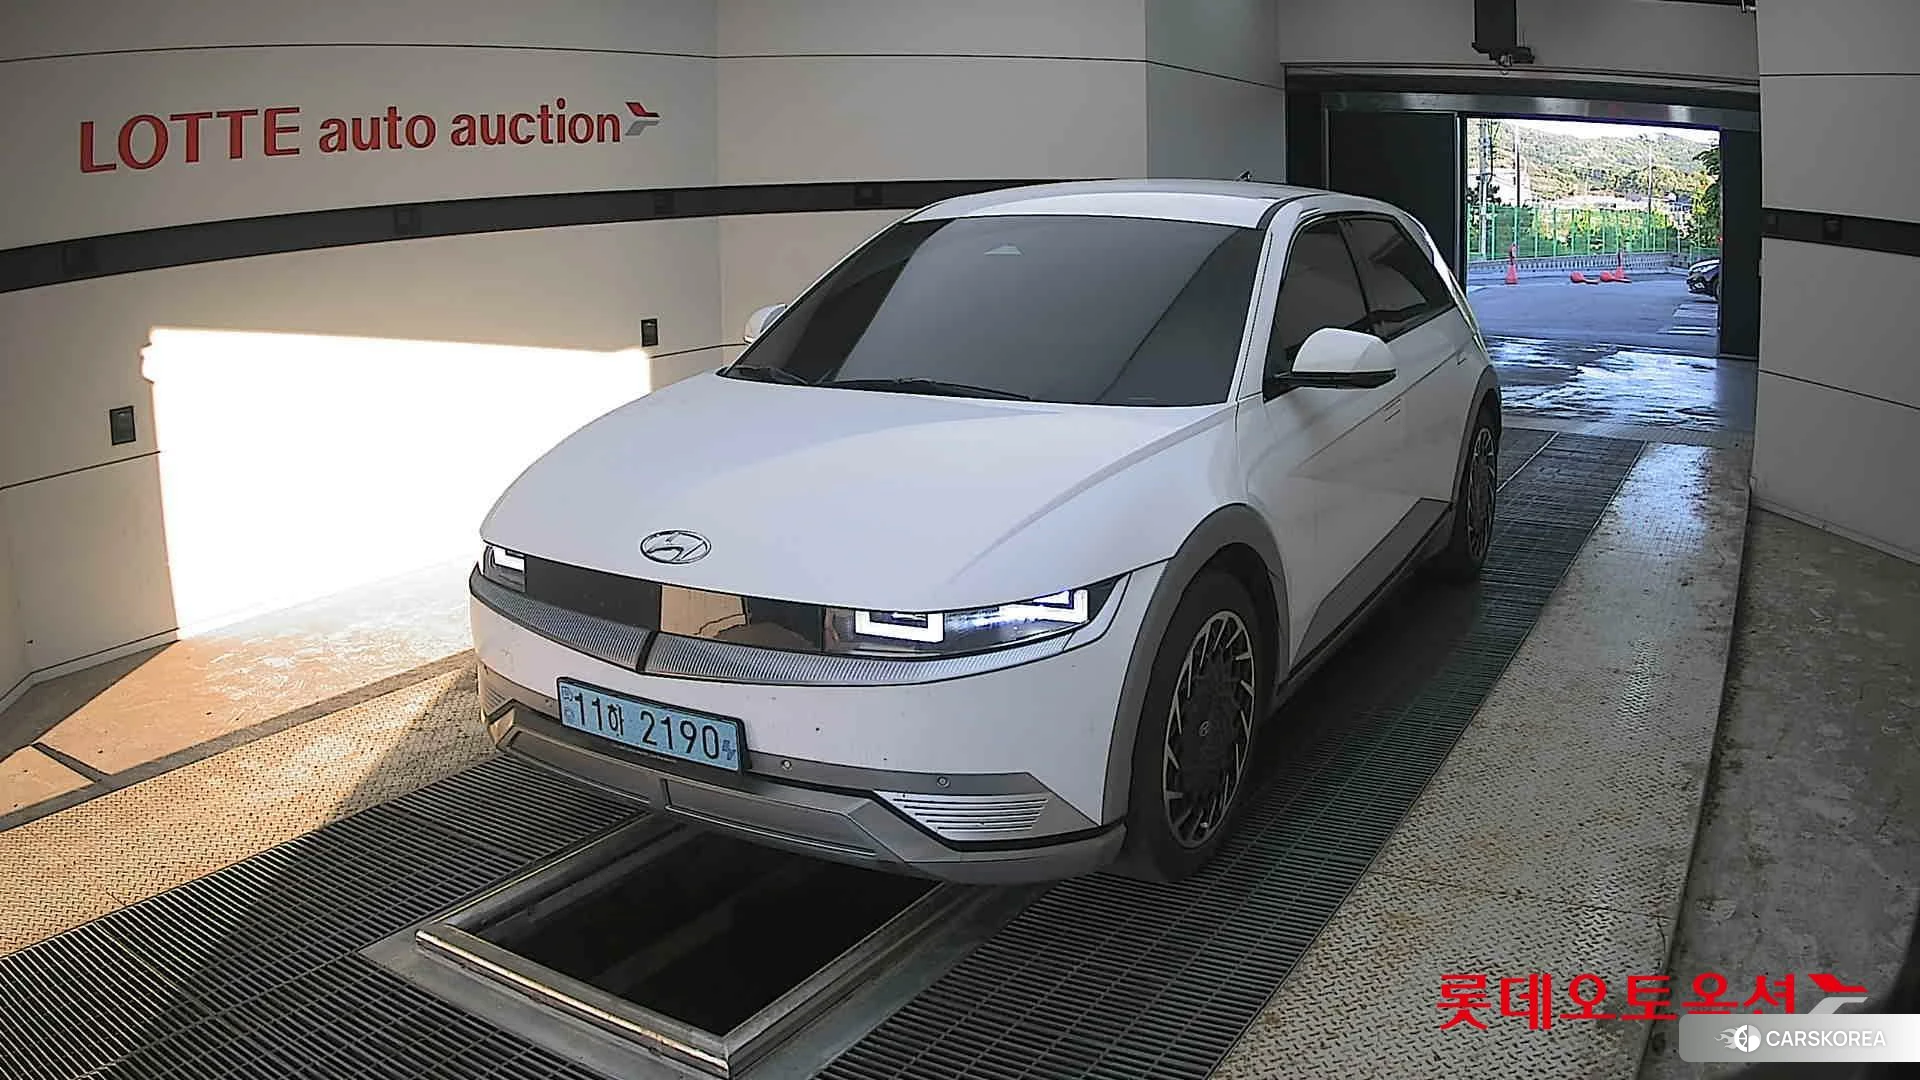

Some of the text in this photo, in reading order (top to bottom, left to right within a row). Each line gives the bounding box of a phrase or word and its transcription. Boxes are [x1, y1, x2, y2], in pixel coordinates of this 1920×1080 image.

[79, 97, 621, 173] LOTTE auto auction
[574, 692, 720, 760] 11하 2190
